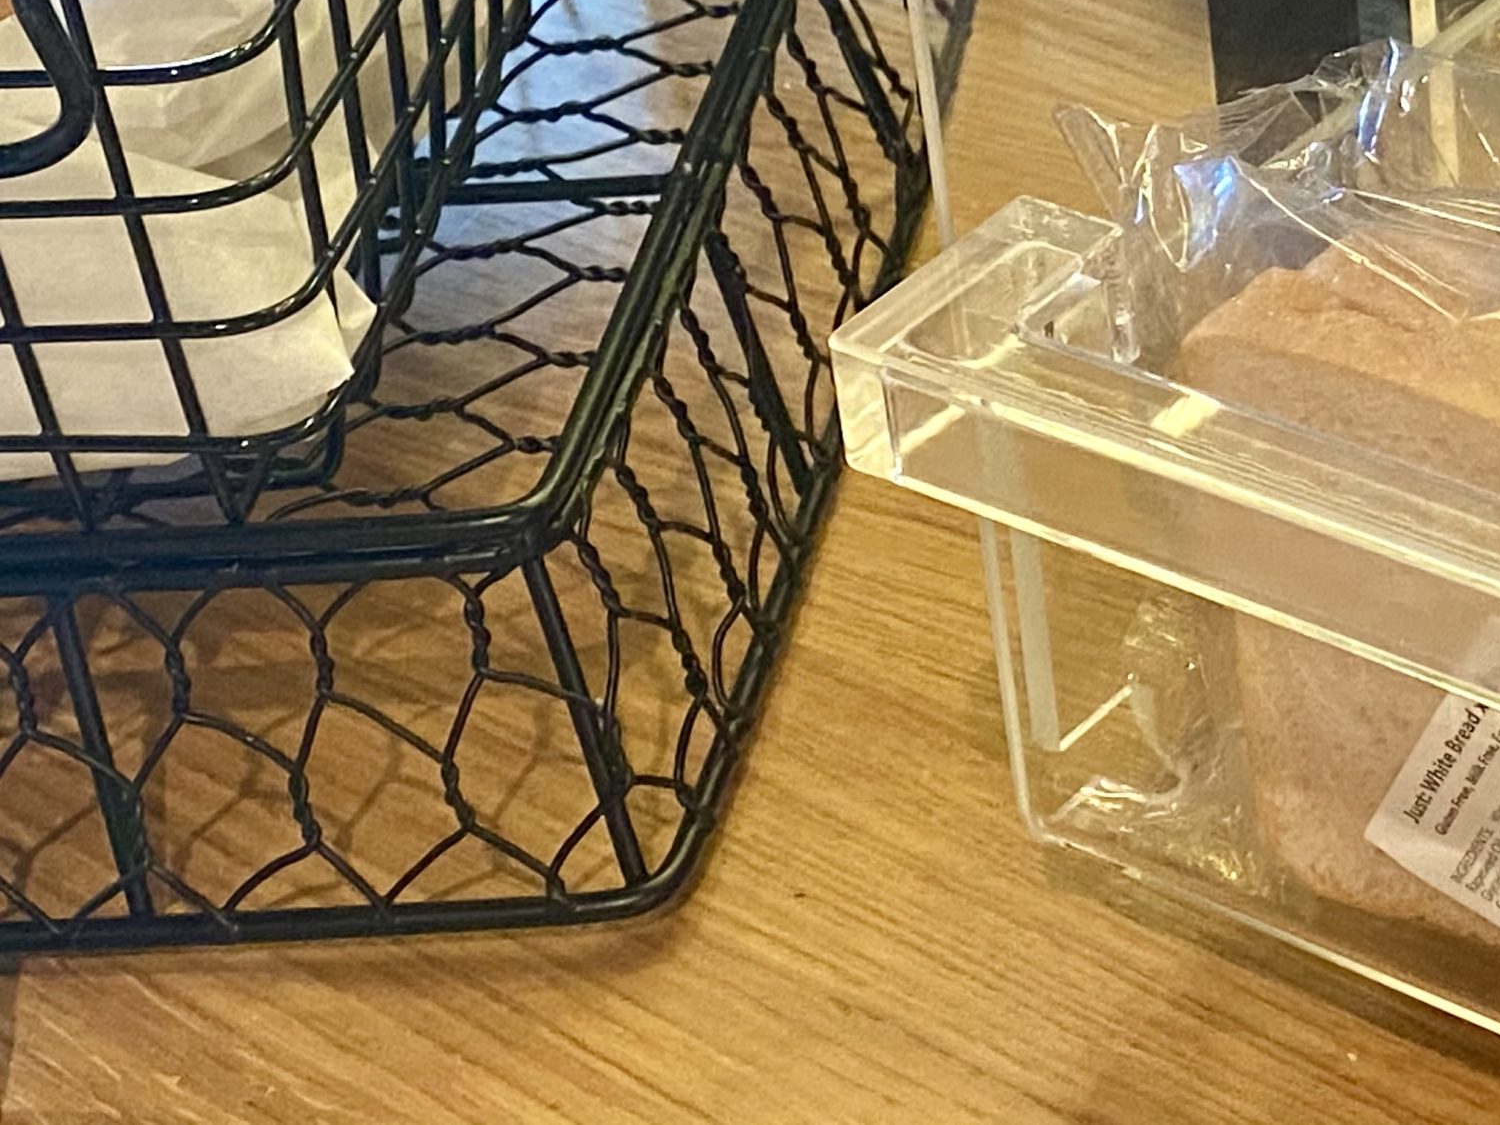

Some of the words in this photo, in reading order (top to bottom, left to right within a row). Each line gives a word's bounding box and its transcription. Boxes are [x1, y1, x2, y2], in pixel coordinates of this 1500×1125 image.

[1401, 789, 1433, 824] Just:
[1420, 749, 1458, 794] White
[1443, 707, 1483, 755] Bread
